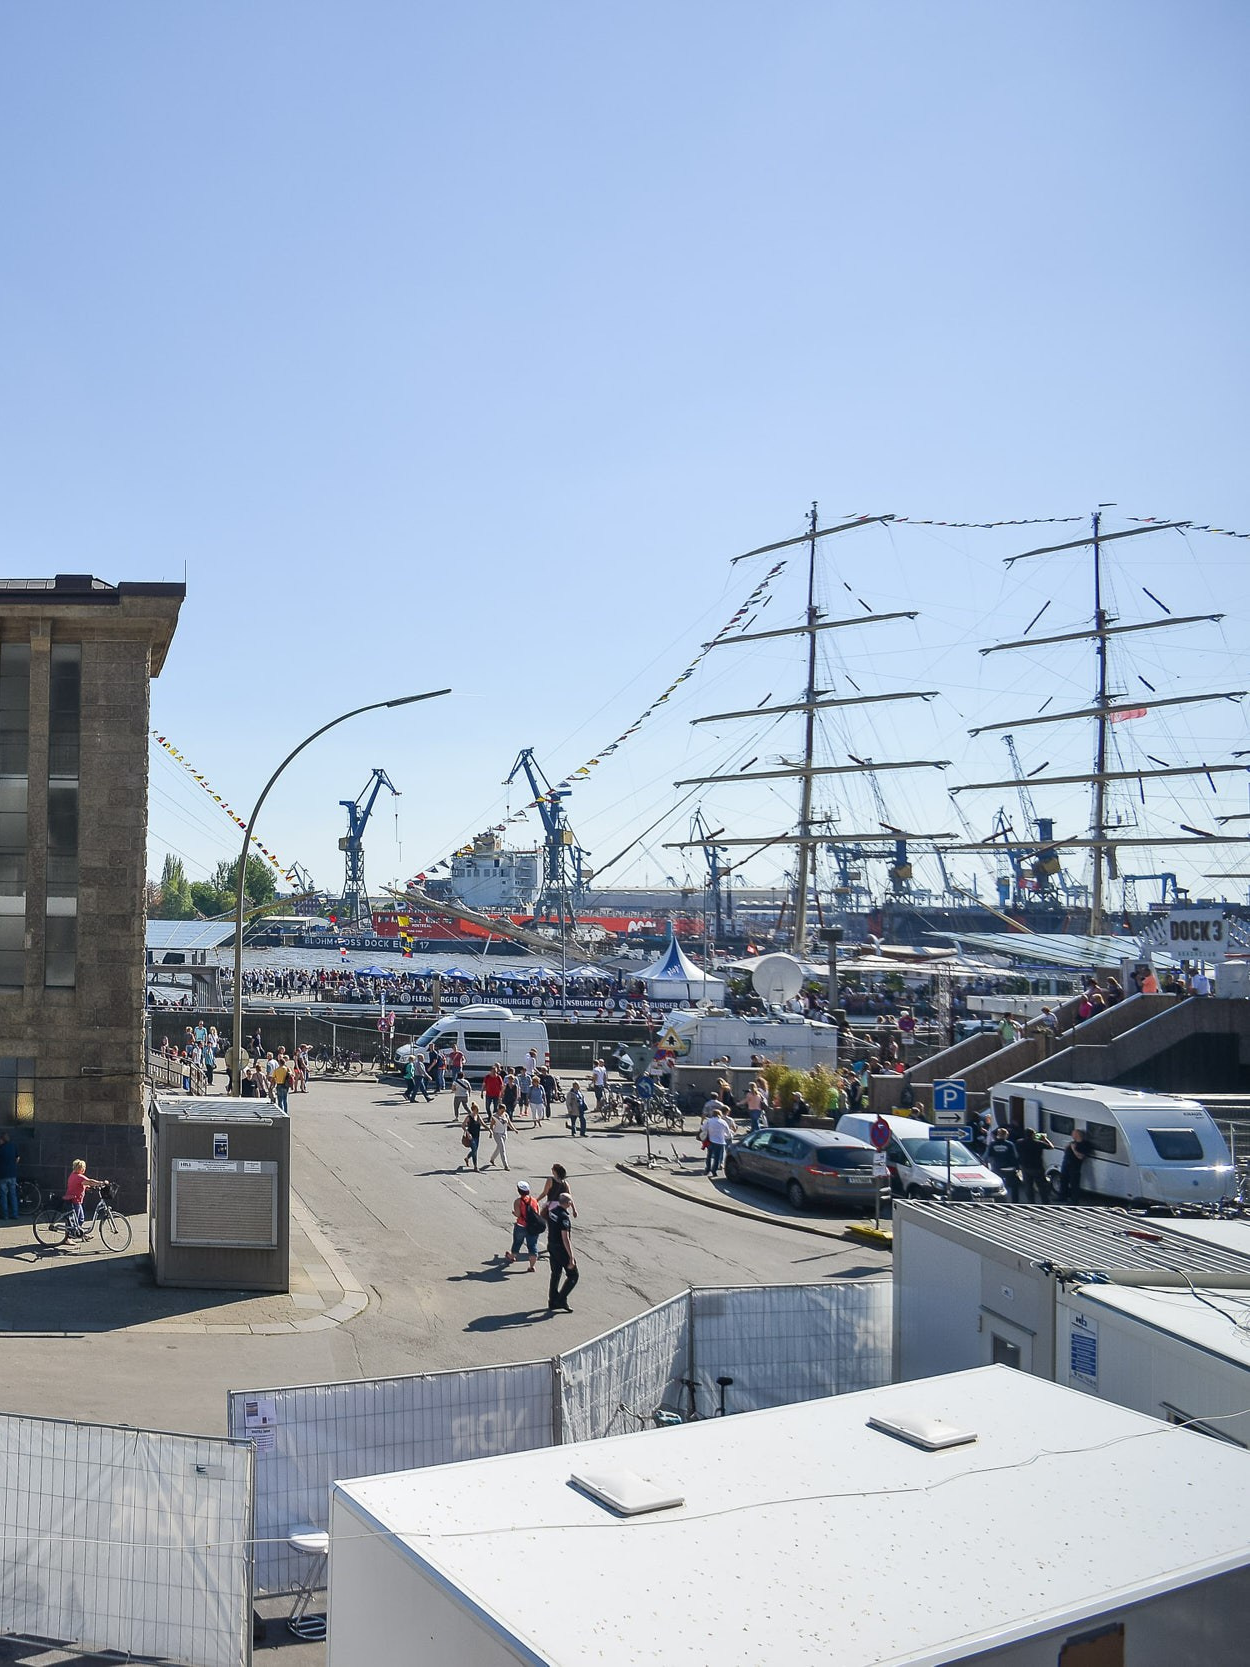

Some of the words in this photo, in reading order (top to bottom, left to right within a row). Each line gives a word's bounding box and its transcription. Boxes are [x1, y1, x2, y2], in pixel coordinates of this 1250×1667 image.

[1170, 920, 1210, 941] DOCK
[1212, 920, 1222, 941] 3
[364, 940, 389, 948] DOCK
[419, 941, 430, 949] 17
[411, 995, 459, 1003] FLENSRGER
[483, 997, 530, 1005] FLENSBURGER
[747, 1032, 766, 1047] NDR
[943, 1089, 958, 1108] P
